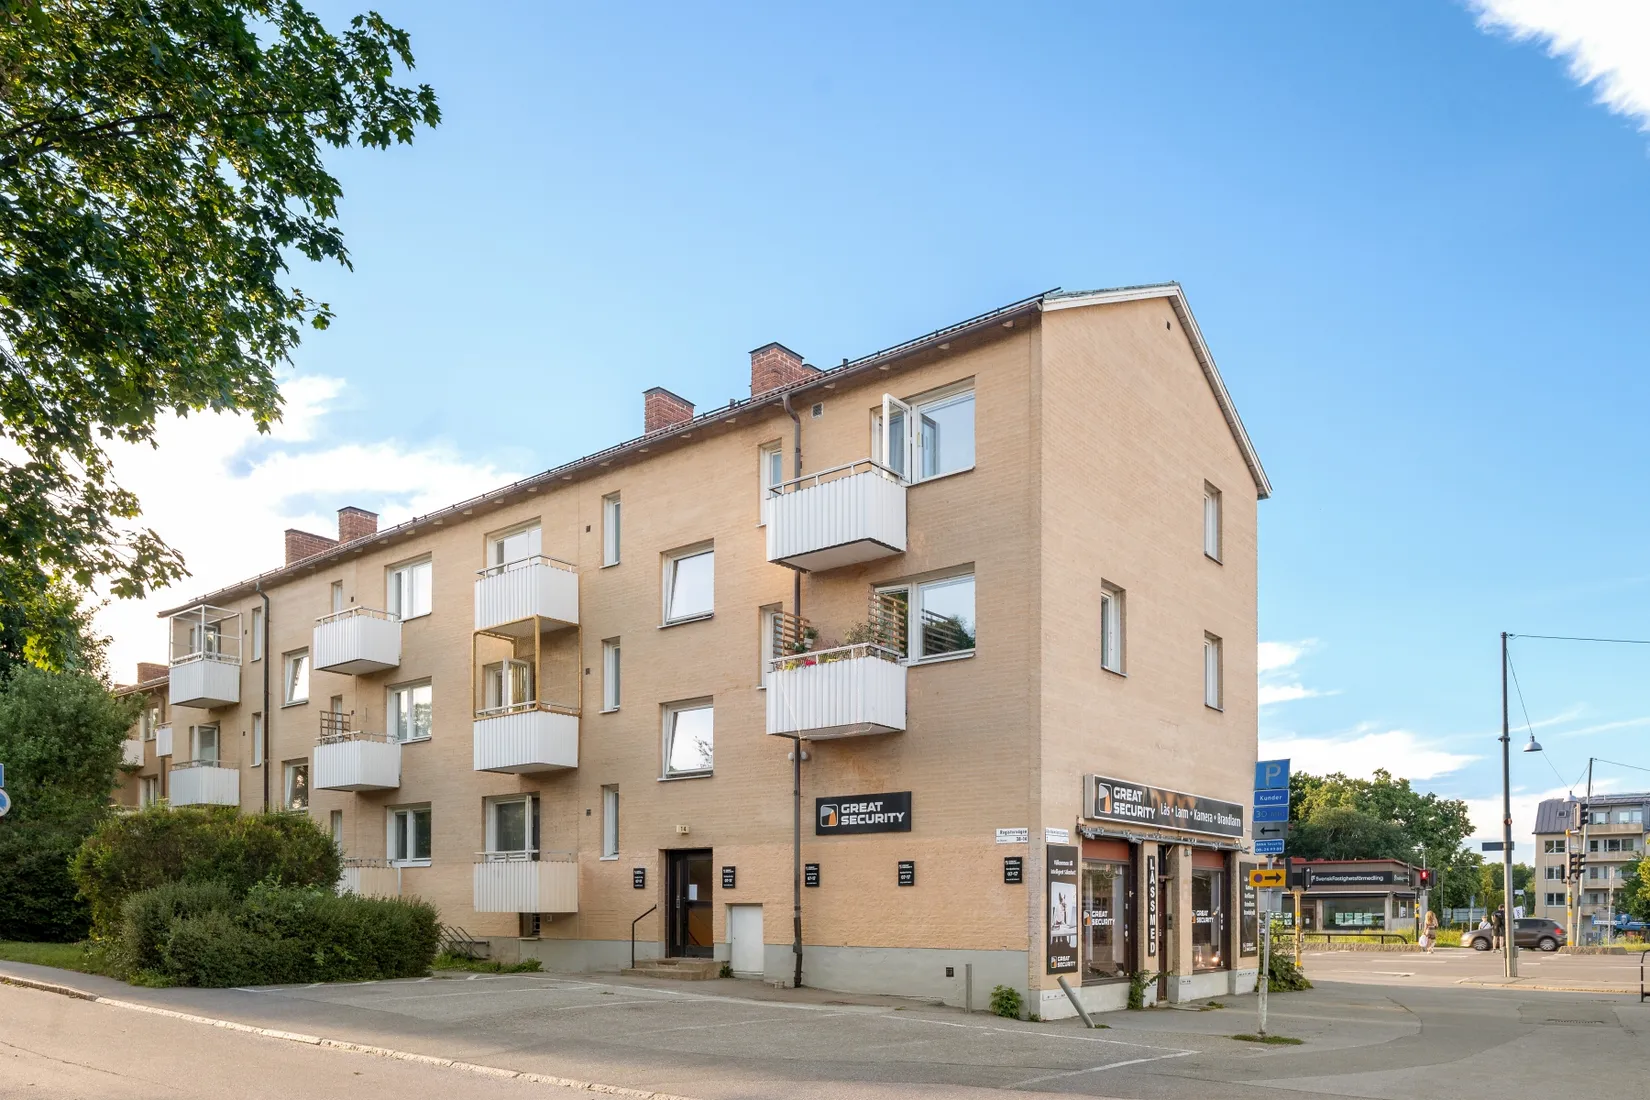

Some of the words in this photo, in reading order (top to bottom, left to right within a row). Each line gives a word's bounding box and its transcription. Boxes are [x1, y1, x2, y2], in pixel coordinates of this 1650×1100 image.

[1265, 763, 1281, 787] P
[1113, 786, 1143, 803] GREAT
[841, 801, 883, 814] GREAT
[1113, 802, 1156, 820] SECURITY
[1160, 802, 1170, 816] Lås
[1175, 805, 1189, 819] Larm
[1193, 809, 1213, 823] Kamera
[1217, 812, 1241, 828] Brandlarm
[841, 812, 905, 825] SECURITY
[1091, 910, 1108, 918] GREAT
[1091, 918, 1116, 926] SECURITY
